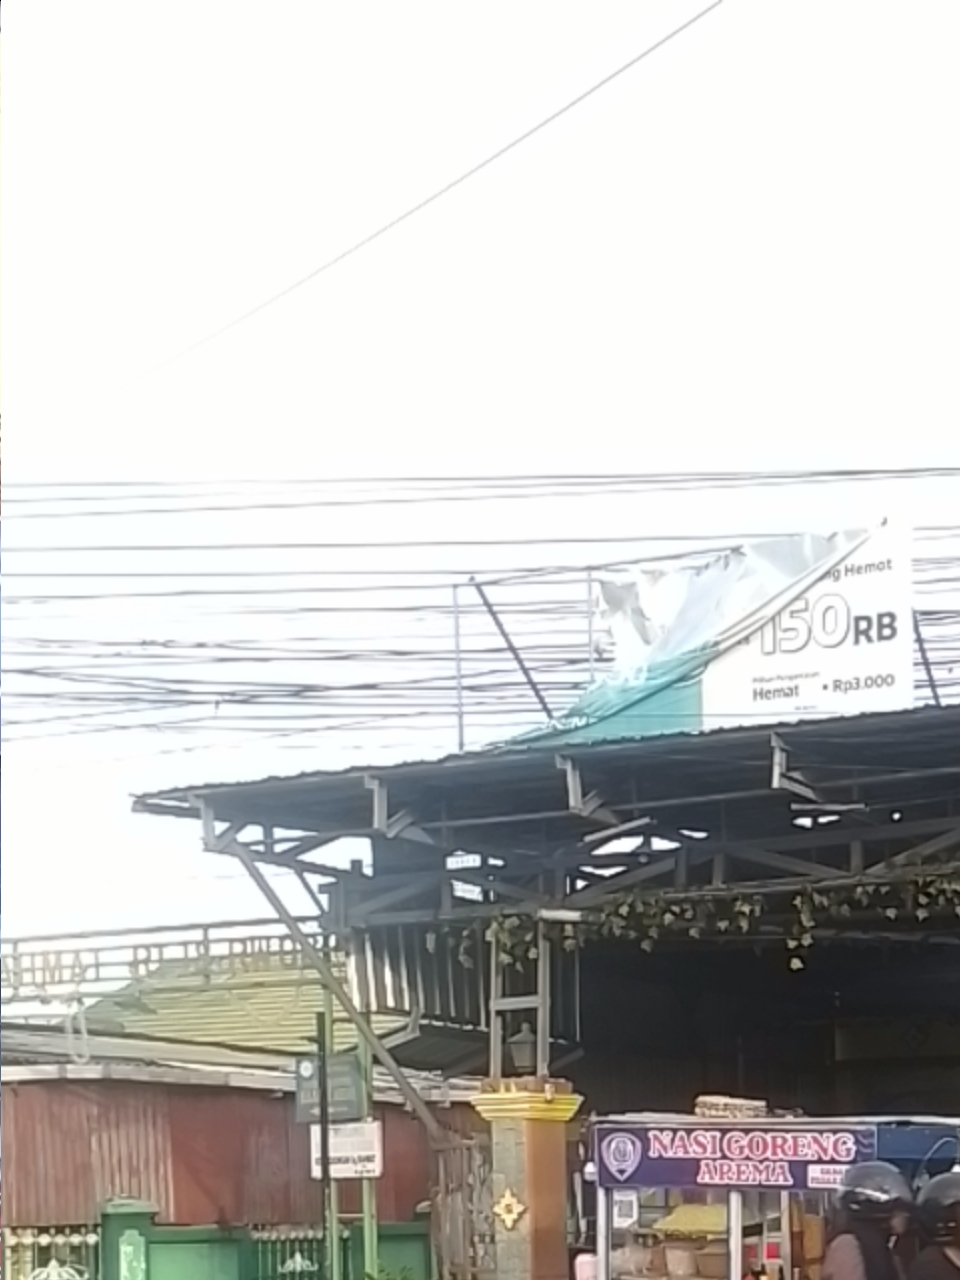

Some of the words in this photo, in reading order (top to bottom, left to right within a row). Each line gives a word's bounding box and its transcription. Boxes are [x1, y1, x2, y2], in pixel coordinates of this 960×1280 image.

[752, 684, 799, 702] Hemat
[832, 673, 896, 694] Rp3.000
[648, 1130, 721, 1159] NASI
[723, 1132, 856, 1161] GORENG
[697, 1160, 793, 1185] AREMA
